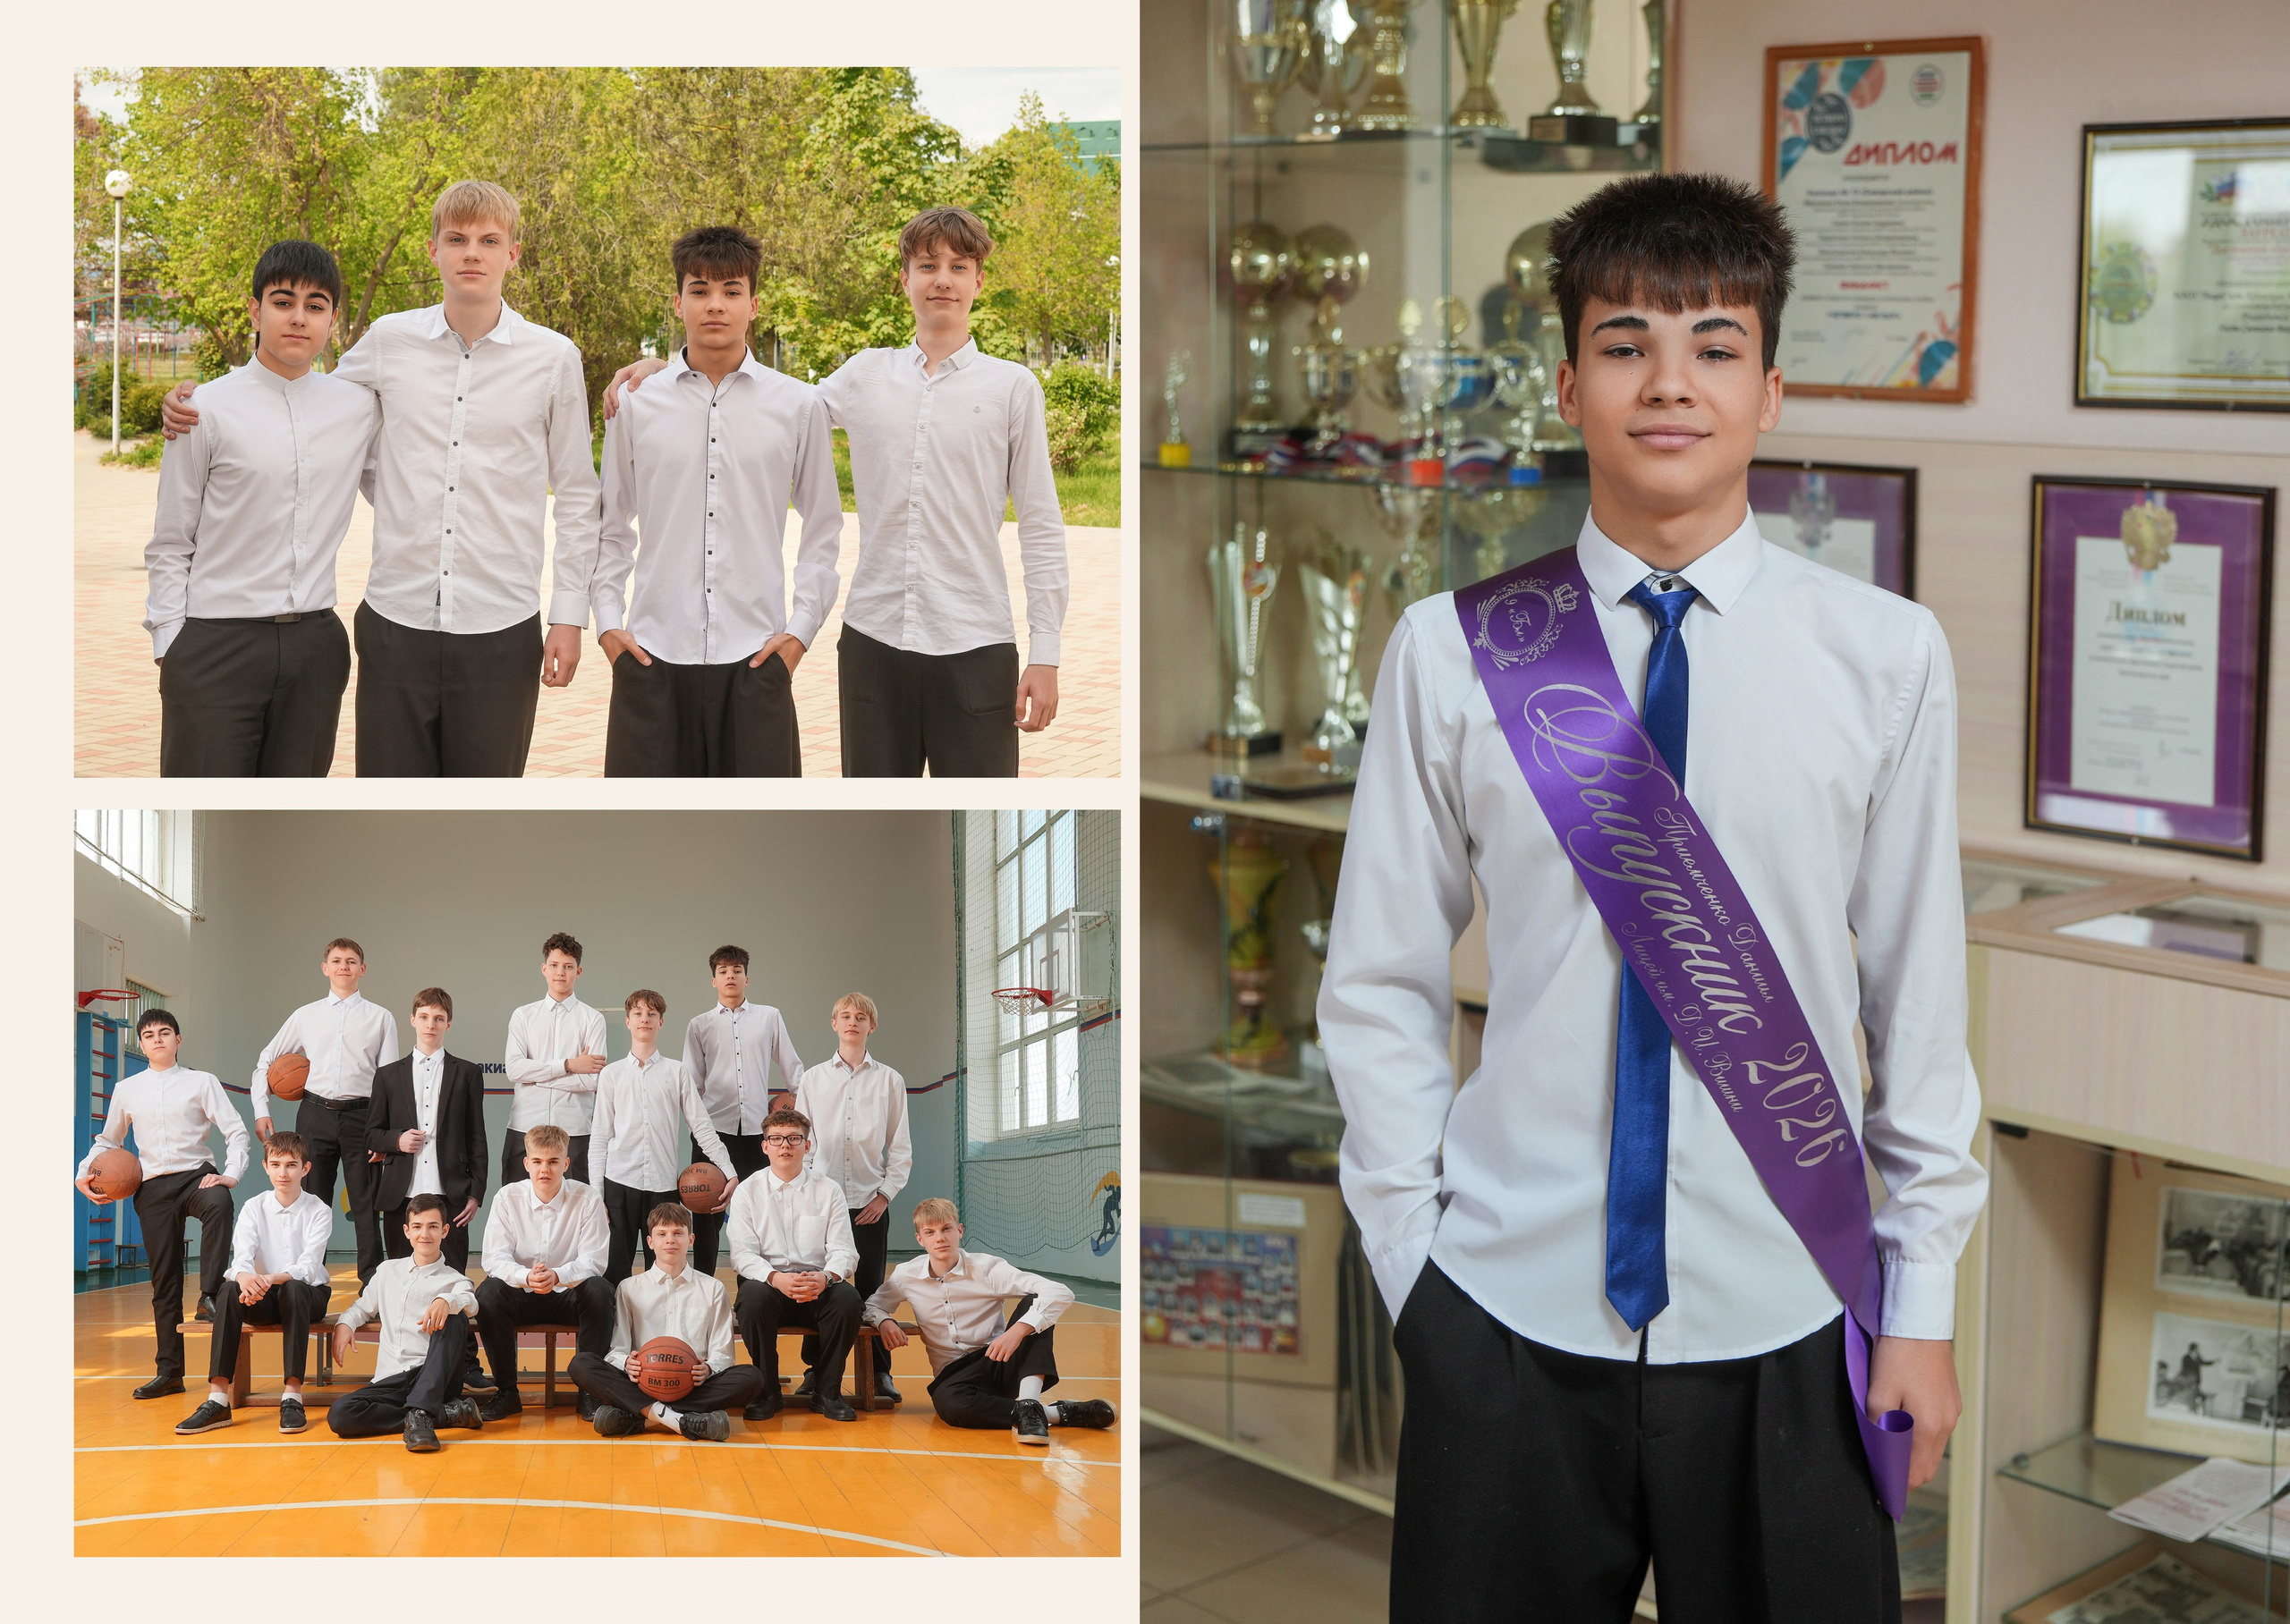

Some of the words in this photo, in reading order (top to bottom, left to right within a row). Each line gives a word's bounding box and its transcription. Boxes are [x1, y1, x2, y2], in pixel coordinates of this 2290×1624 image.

[1844, 141, 1958, 165] ДИПЛОМ
[2104, 598, 2186, 628] Диплом
[1654, 807, 1731, 926] Приемченко
[1727, 923, 1775, 1003] Даниил
[1523, 683, 1762, 1036] Выпускник
[1742, 1041, 1850, 1167] 2026
[1621, 922, 1665, 979] Лицей
[1655, 981, 1675, 1007] им.
[1704, 1051, 1743, 1113] Вишни
[681, 1184, 711, 1194] TORRES
[646, 1353, 684, 1365] TORRES
[648, 1377, 662, 1386] BM
[663, 1379, 681, 1387] 300
